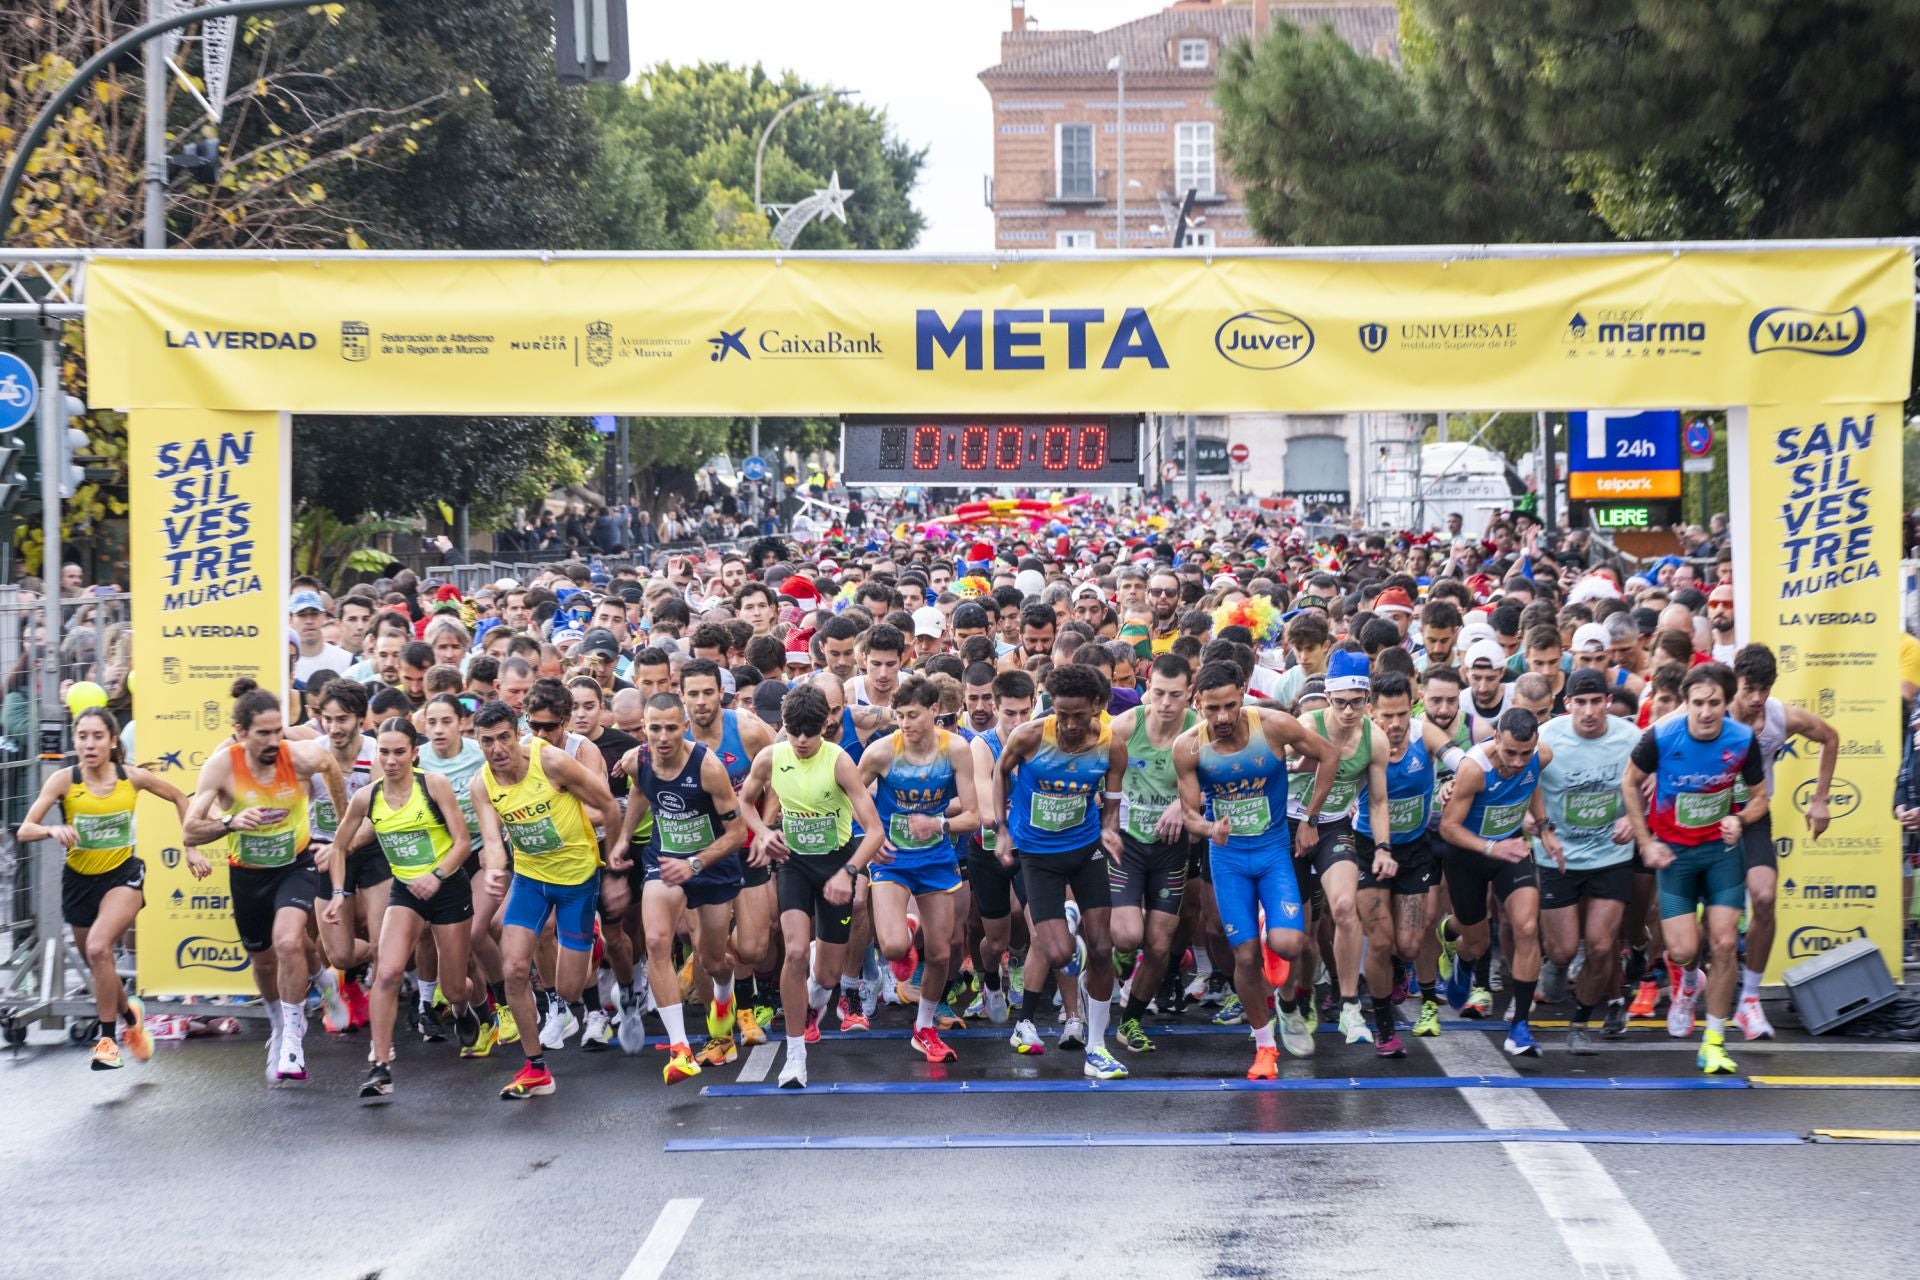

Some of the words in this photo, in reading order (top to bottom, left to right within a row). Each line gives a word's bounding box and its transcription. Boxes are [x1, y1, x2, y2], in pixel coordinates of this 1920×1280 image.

[165, 330, 199, 348] LA
[205, 331, 317, 350] VERDAD
[436, 333, 447, 343] de
[916, 307, 1170, 370] META
[1226, 330, 1303, 350] Juver
[1402, 323, 1518, 339] UNIVERSAE
[1598, 322, 1705, 343] marmo
[1767, 321, 1850, 343] VIDAL
[759, 330, 883, 353] CaixaBank
[634, 349, 673, 358] Murcia
[1616, 439, 1656, 458] 24h
[1774, 414, 1875, 464] SAN
[154, 431, 255, 479] SAN
[1597, 476, 1652, 494] telpark
[1789, 455, 1860, 499] SIL
[168, 470, 239, 513] SIL
[1600, 509, 1648, 525] LIBRE
[1779, 487, 1871, 537] VES
[160, 503, 252, 550] VES
[1778, 526, 1874, 574] TRE
[161, 541, 255, 586] TRE
[1780, 560, 1880, 599] MURCIA
[162, 575, 262, 610] MURCIA
[1779, 614, 1801, 625] LA
[1806, 612, 1876, 625] VERDAD
[162, 625, 184, 637] LA
[188, 625, 259, 637] VERDAD
[1804, 739, 1884, 756] CaBank
[1801, 791, 1853, 806] Jver
[670, 832, 702, 844] 1755
[797, 833, 826, 844] 092
[393, 845, 419, 858] 156
[1804, 885, 1876, 899] marmo
[191, 895, 233, 909] mar
[188, 947, 243, 961] VIDAL
